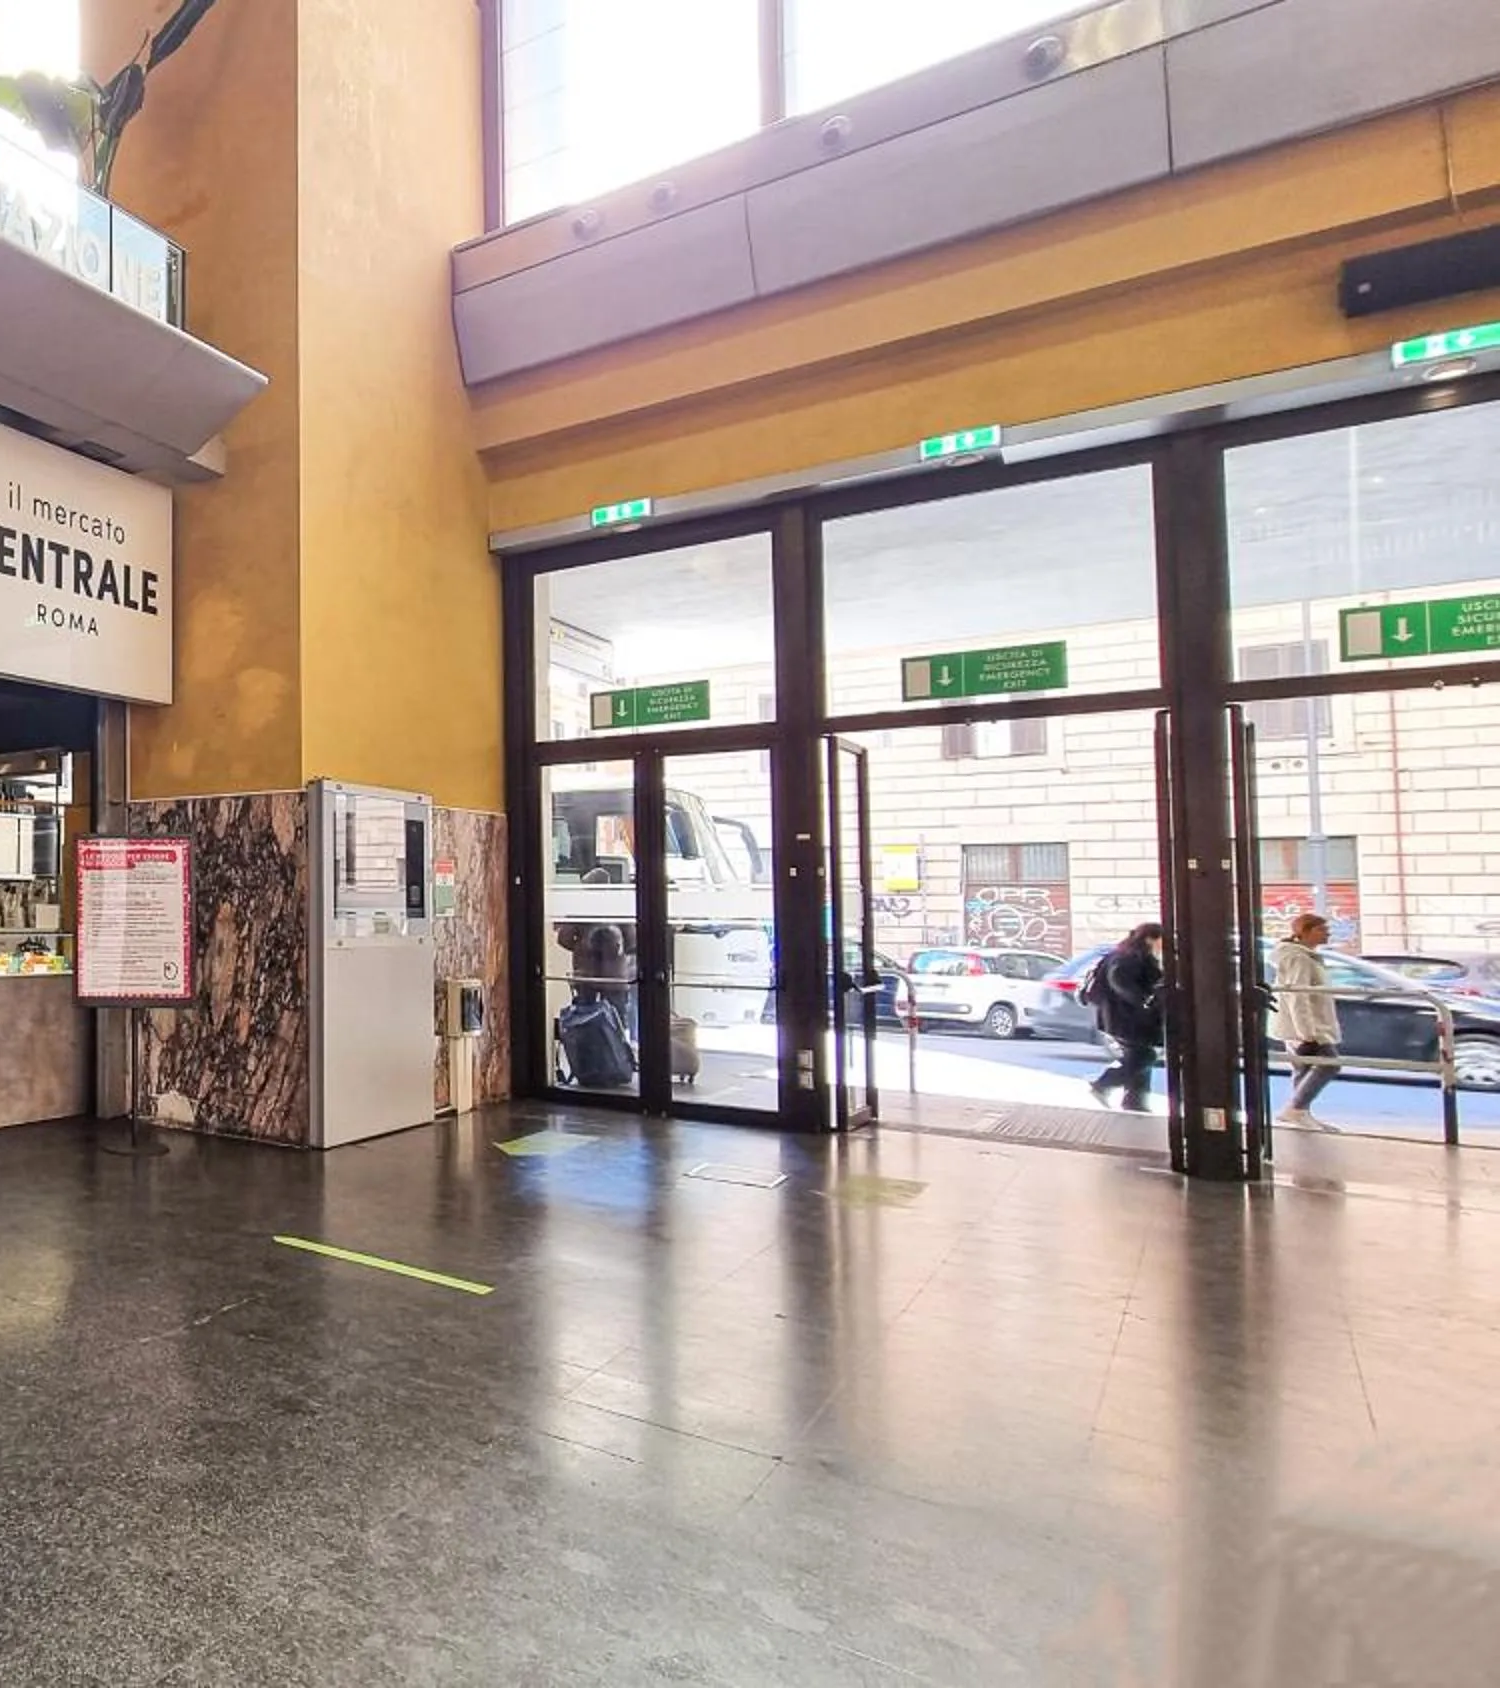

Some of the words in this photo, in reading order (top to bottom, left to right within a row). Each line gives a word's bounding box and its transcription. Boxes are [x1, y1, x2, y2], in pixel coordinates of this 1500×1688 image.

[8, 481, 21, 511] il
[33, 497, 125, 544] mercato
[37, 603, 99, 636] ROMA
[983, 659, 1048, 671] SICUREZZA
[979, 667, 1051, 681] EMERGENCY
[1003, 680, 1027, 689] EXIT
